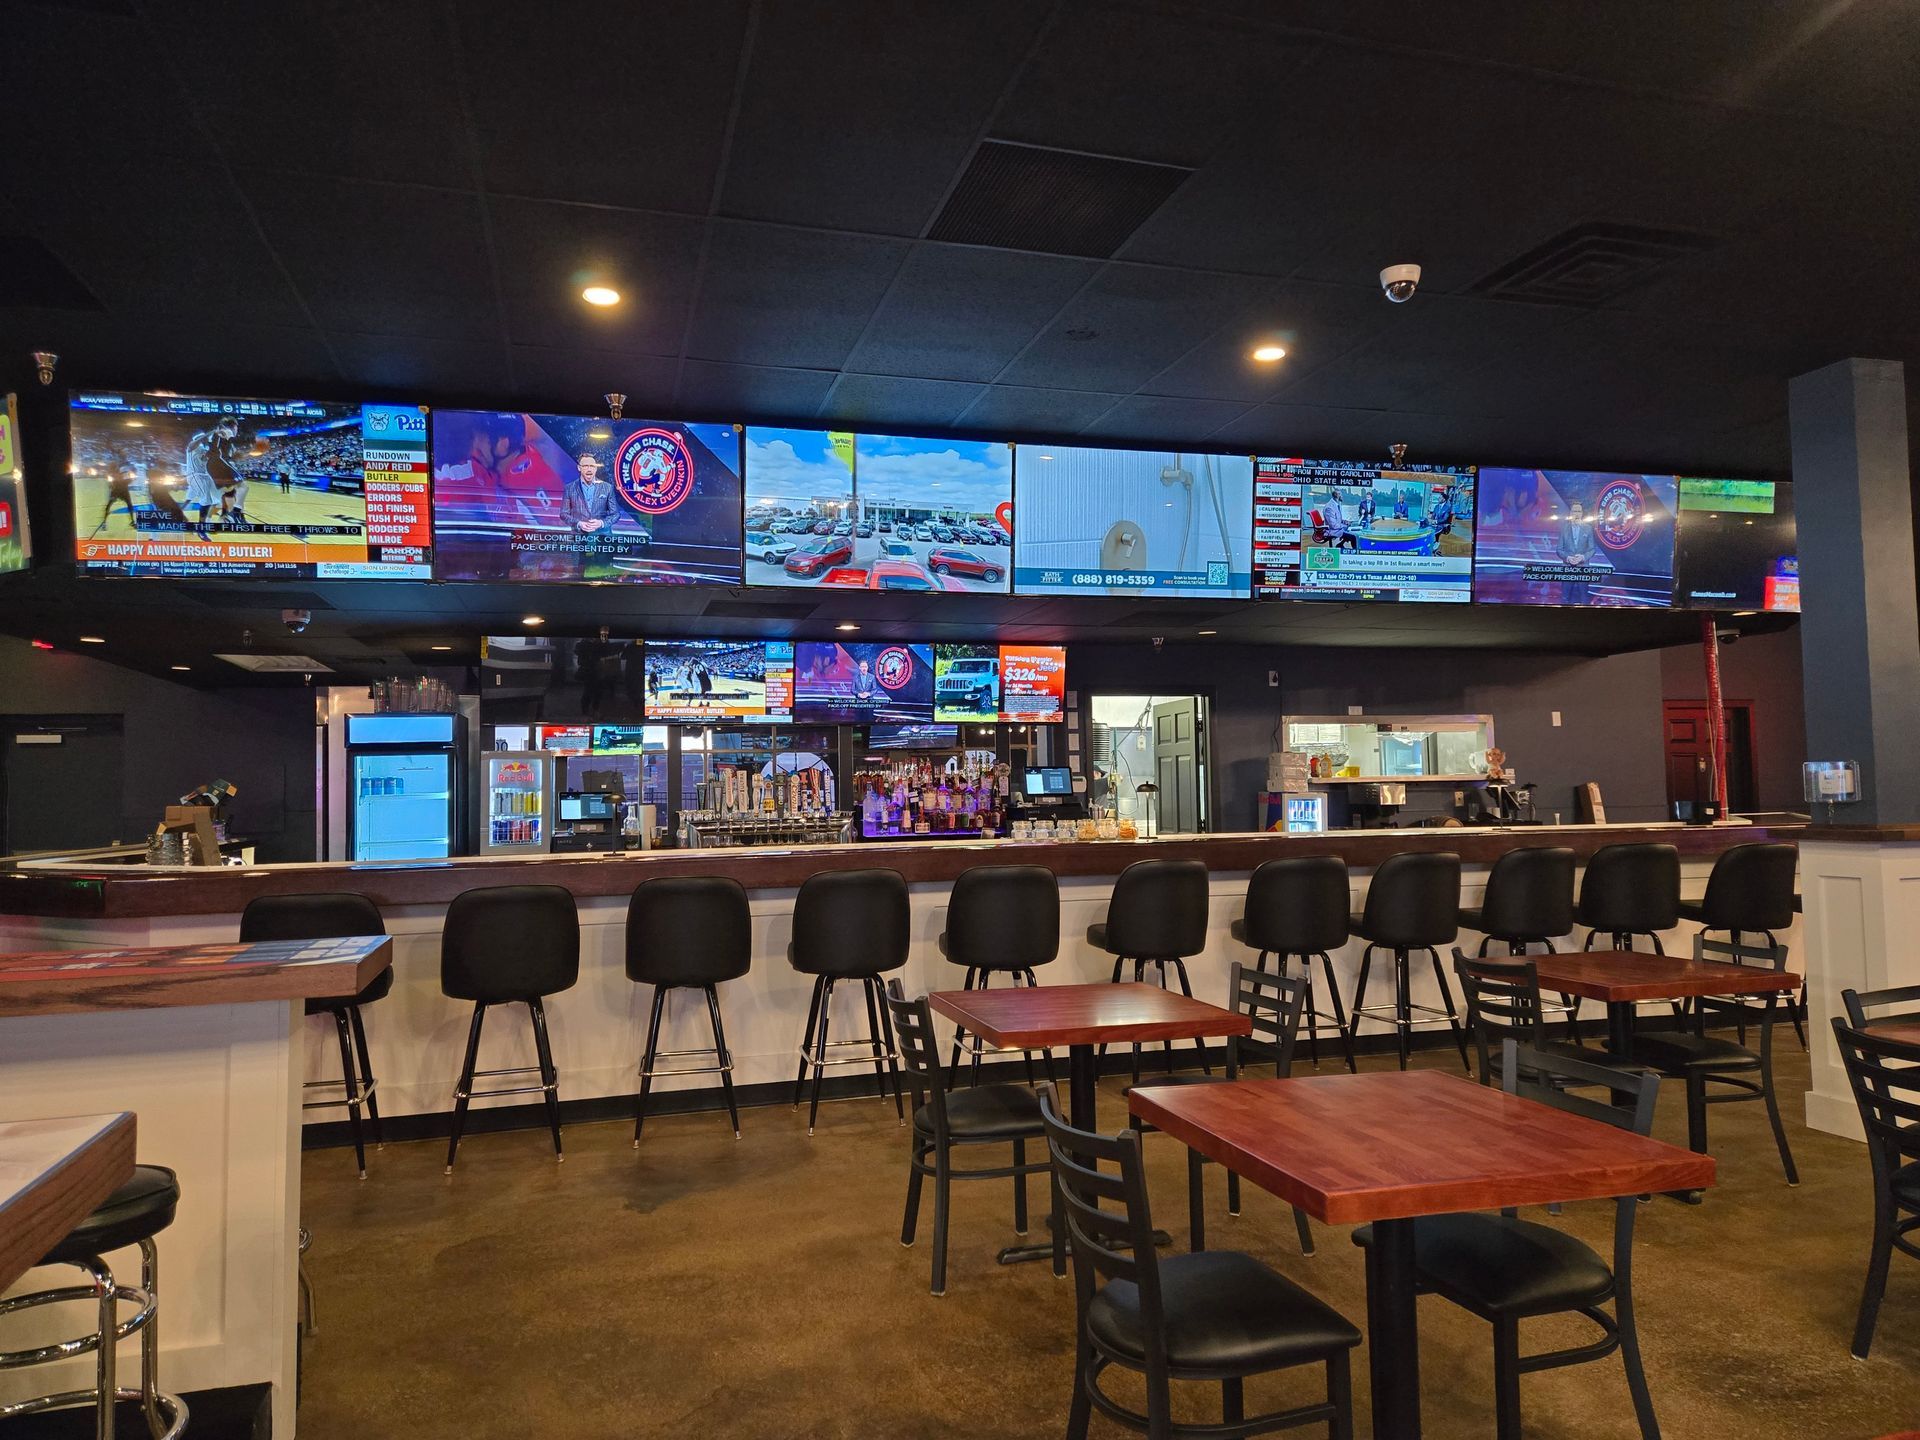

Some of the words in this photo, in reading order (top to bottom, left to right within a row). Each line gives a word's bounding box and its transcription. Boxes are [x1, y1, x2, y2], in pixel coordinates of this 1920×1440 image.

[394, 414, 426, 431] Pitt
[365, 451, 411, 461] RUNDOWN
[365, 462, 390, 471] ANDY
[391, 463, 413, 472] REID
[366, 472, 399, 481] BUTLER
[622, 462, 631, 484] THE
[660, 460, 685, 504] OVECHKIN
[366, 483, 425, 493] DODGERS/CUBS
[367, 493, 402, 502] ERRORS
[634, 492, 658, 506] ALEX
[367, 504, 384, 512] BIG
[385, 504, 415, 513] FINISH
[367, 514, 391, 523] TUSH
[393, 515, 417, 524] PUSH
[136, 522, 151, 530] HE
[158, 522, 187, 531] MADE
[194, 523, 216, 532] THE
[222, 524, 256, 533] FIRST
[263, 525, 292, 533] FREE
[299, 525, 338, 534] THROWS
[344, 526, 359, 534] TO
[368, 525, 410, 533] RODGERS
[368, 535, 403, 544] MILROE
[524, 533, 574, 542] WELCOME
[603, 536, 646, 544] OPENING
[107, 544, 144, 556] HAPPY
[146, 545, 226, 559] ANNIVERSARY,
[228, 547, 273, 558] BUTLER!
[381, 546, 423, 555] PARDON
[559, 544, 615, 553] PRESENTED
[87, 560, 119, 568] ESPN2
[1072, 574, 1103, 585] (888)
[1105, 575, 1155, 586] 819-5359
